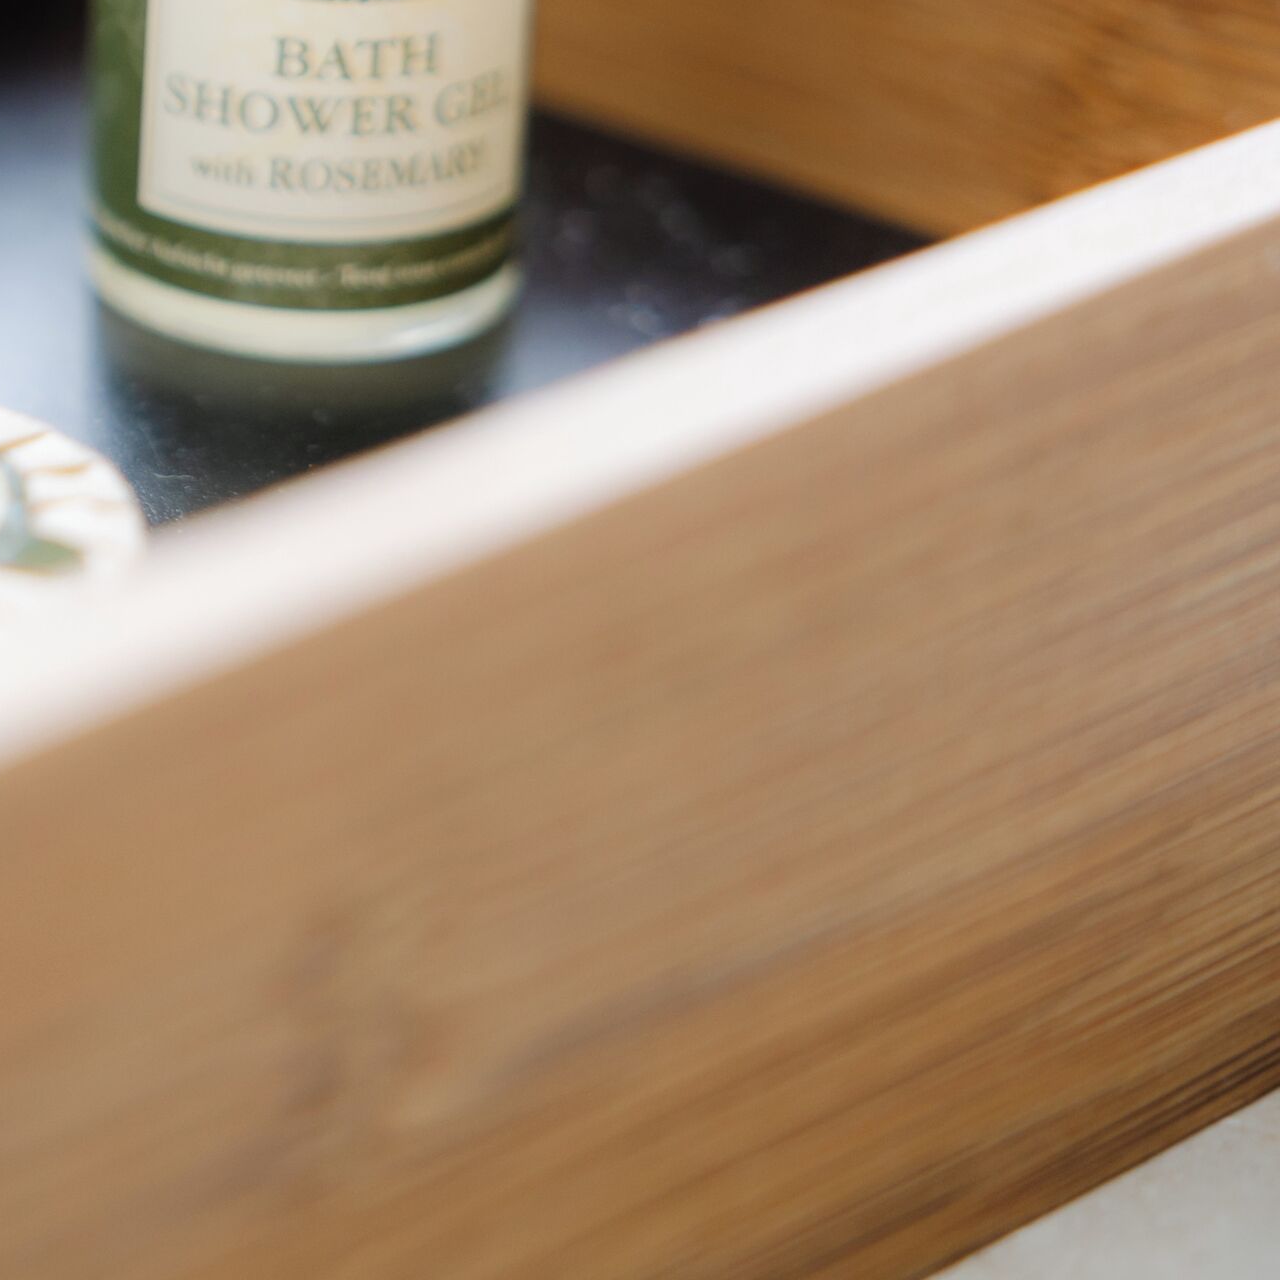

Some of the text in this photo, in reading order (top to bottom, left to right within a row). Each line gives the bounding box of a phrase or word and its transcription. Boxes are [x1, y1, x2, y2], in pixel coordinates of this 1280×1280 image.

[273, 31, 439, 81] BATH
[165, 66, 512, 137] SHOWER GEL
[190, 142, 485, 196] with ROSEMARY
